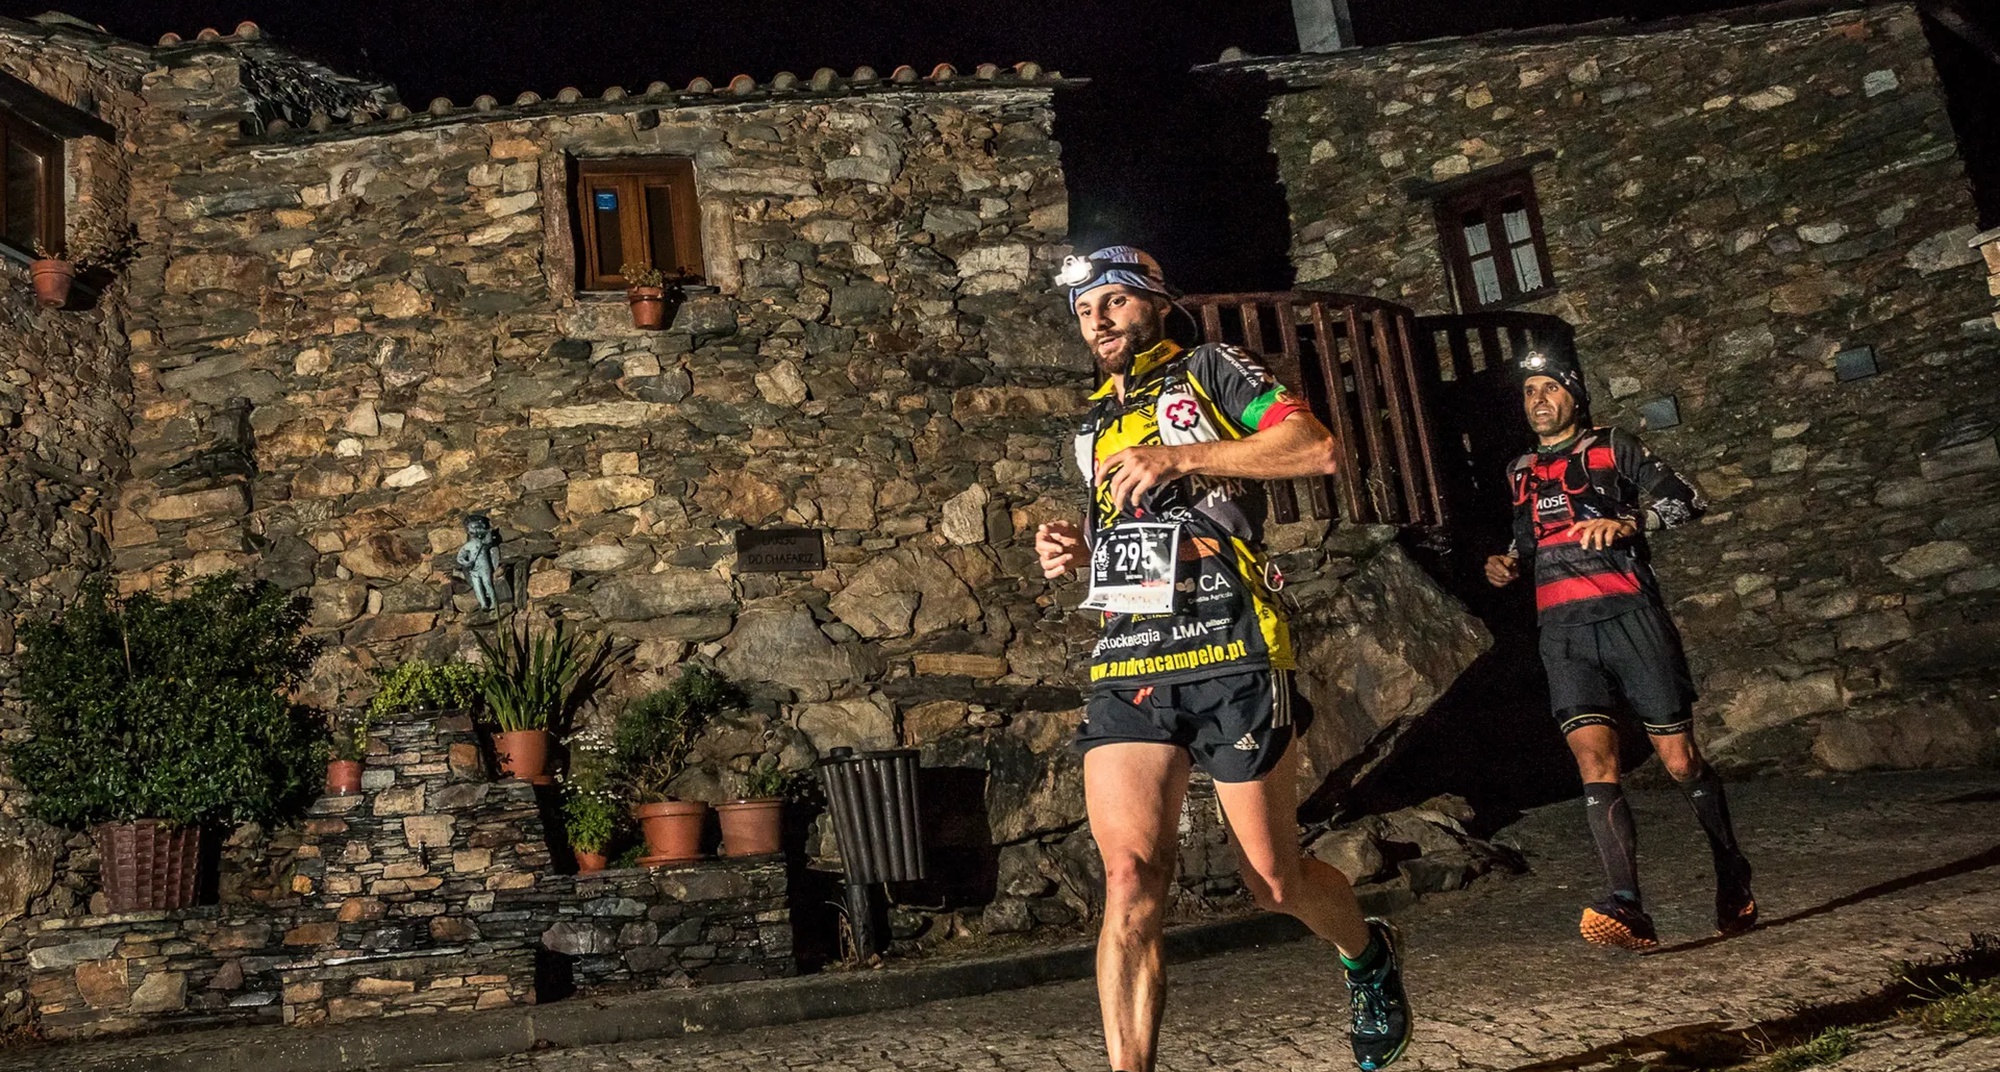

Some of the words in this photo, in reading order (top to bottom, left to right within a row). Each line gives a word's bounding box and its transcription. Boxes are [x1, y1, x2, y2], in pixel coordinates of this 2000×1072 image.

[748, 554, 763, 565] DO
[1114, 541, 1158, 572] 295
[1199, 572, 1231, 592] CA
